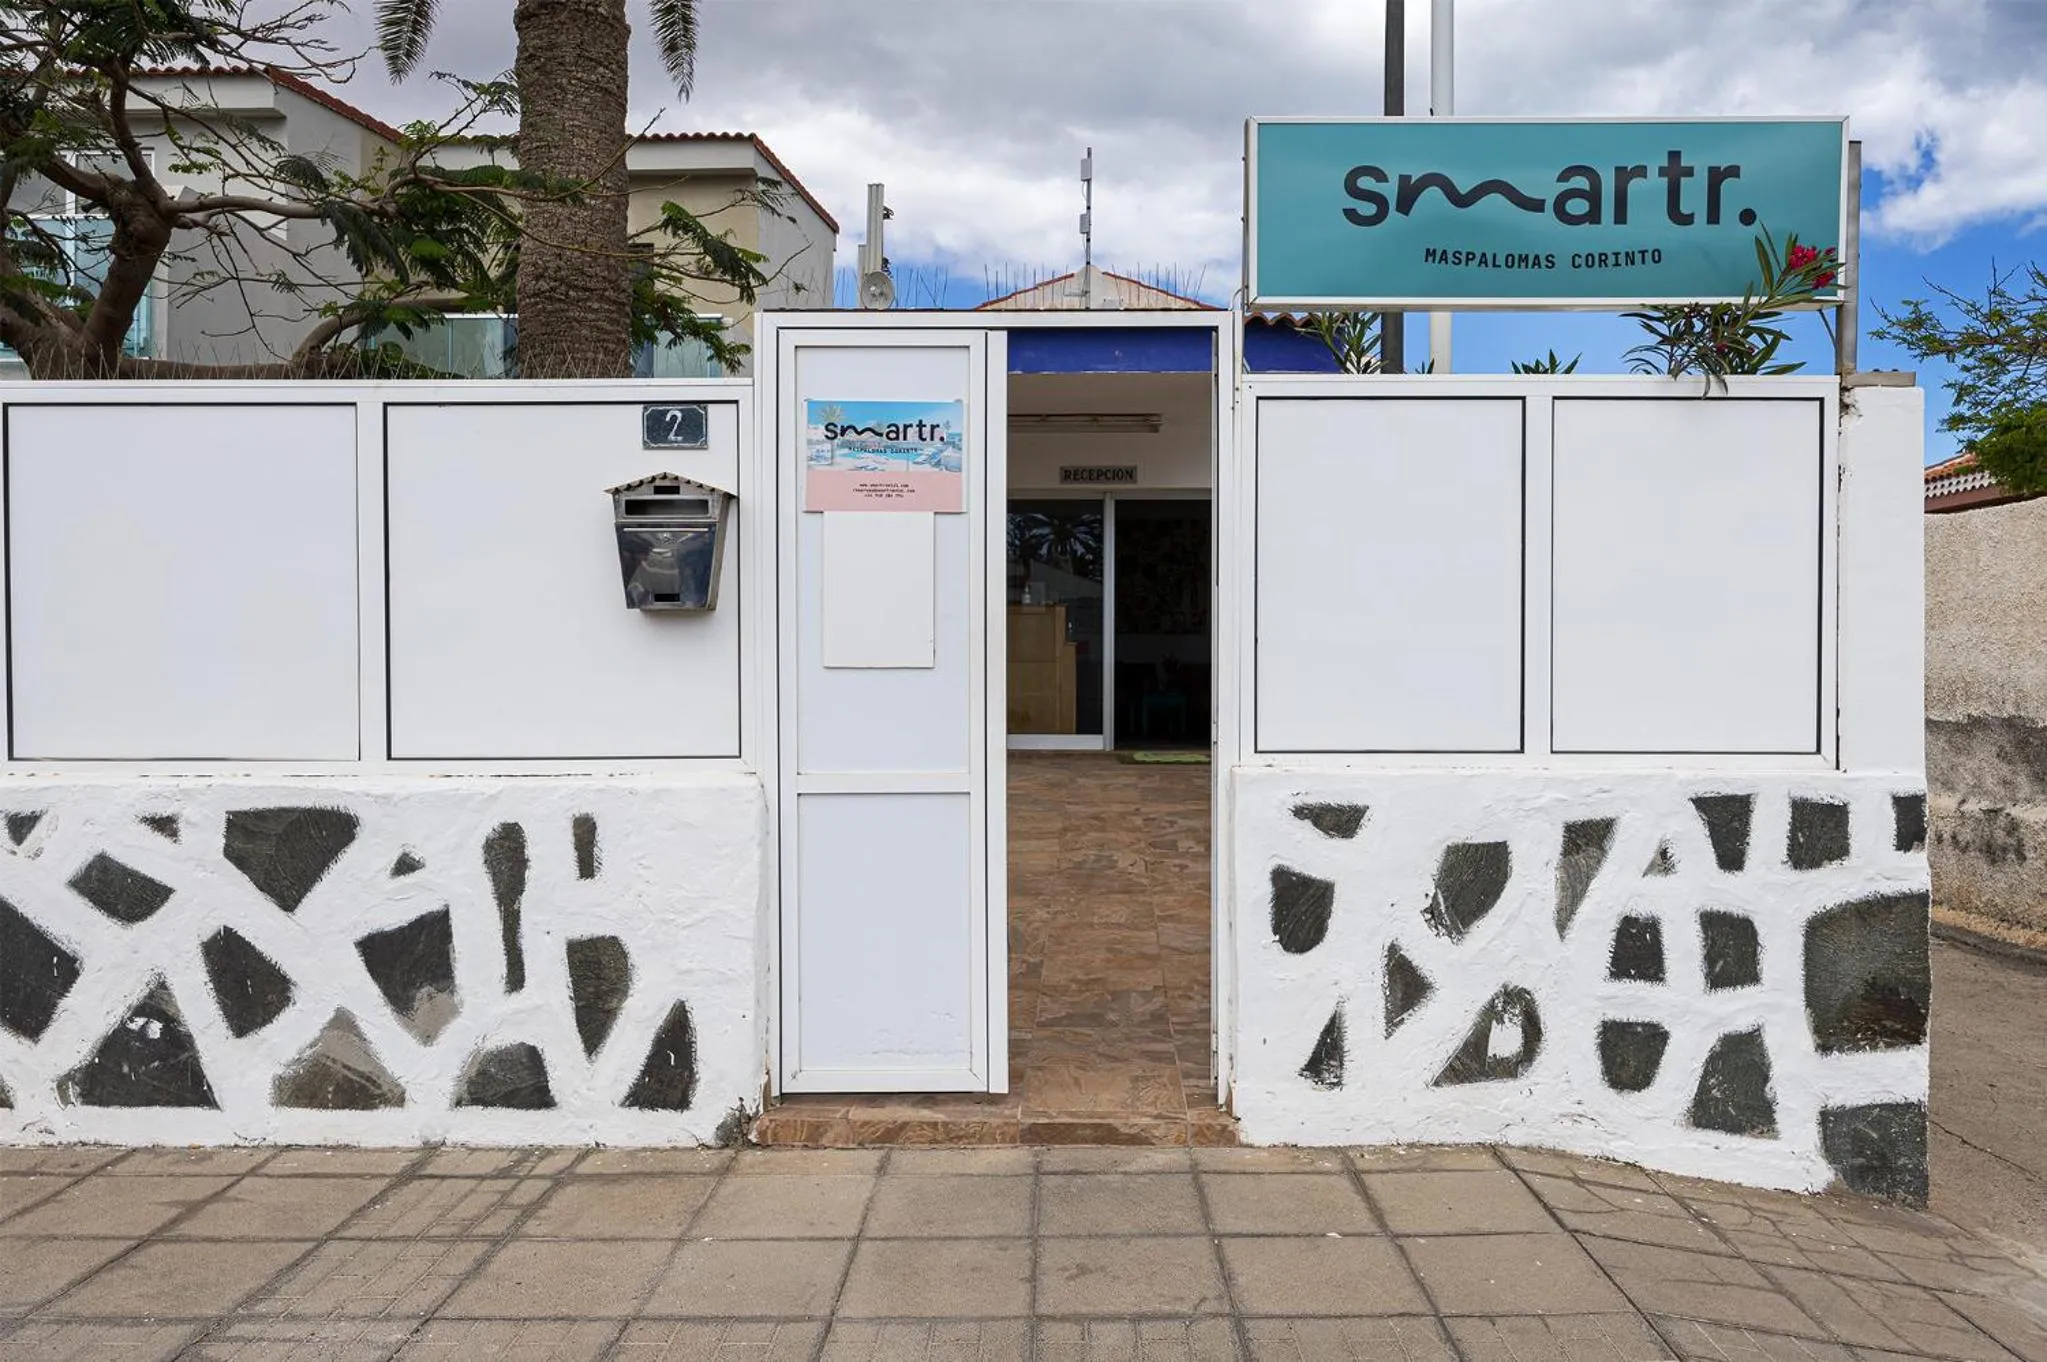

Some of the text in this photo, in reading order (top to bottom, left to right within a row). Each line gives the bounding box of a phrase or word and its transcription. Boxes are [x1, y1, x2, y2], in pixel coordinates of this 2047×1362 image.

[1342, 150, 1758, 227] smartr.
[1424, 247, 1662, 269] MASPALOMAS CORINTO
[665, 409, 684, 441] 2
[824, 419, 945, 442] smartr.
